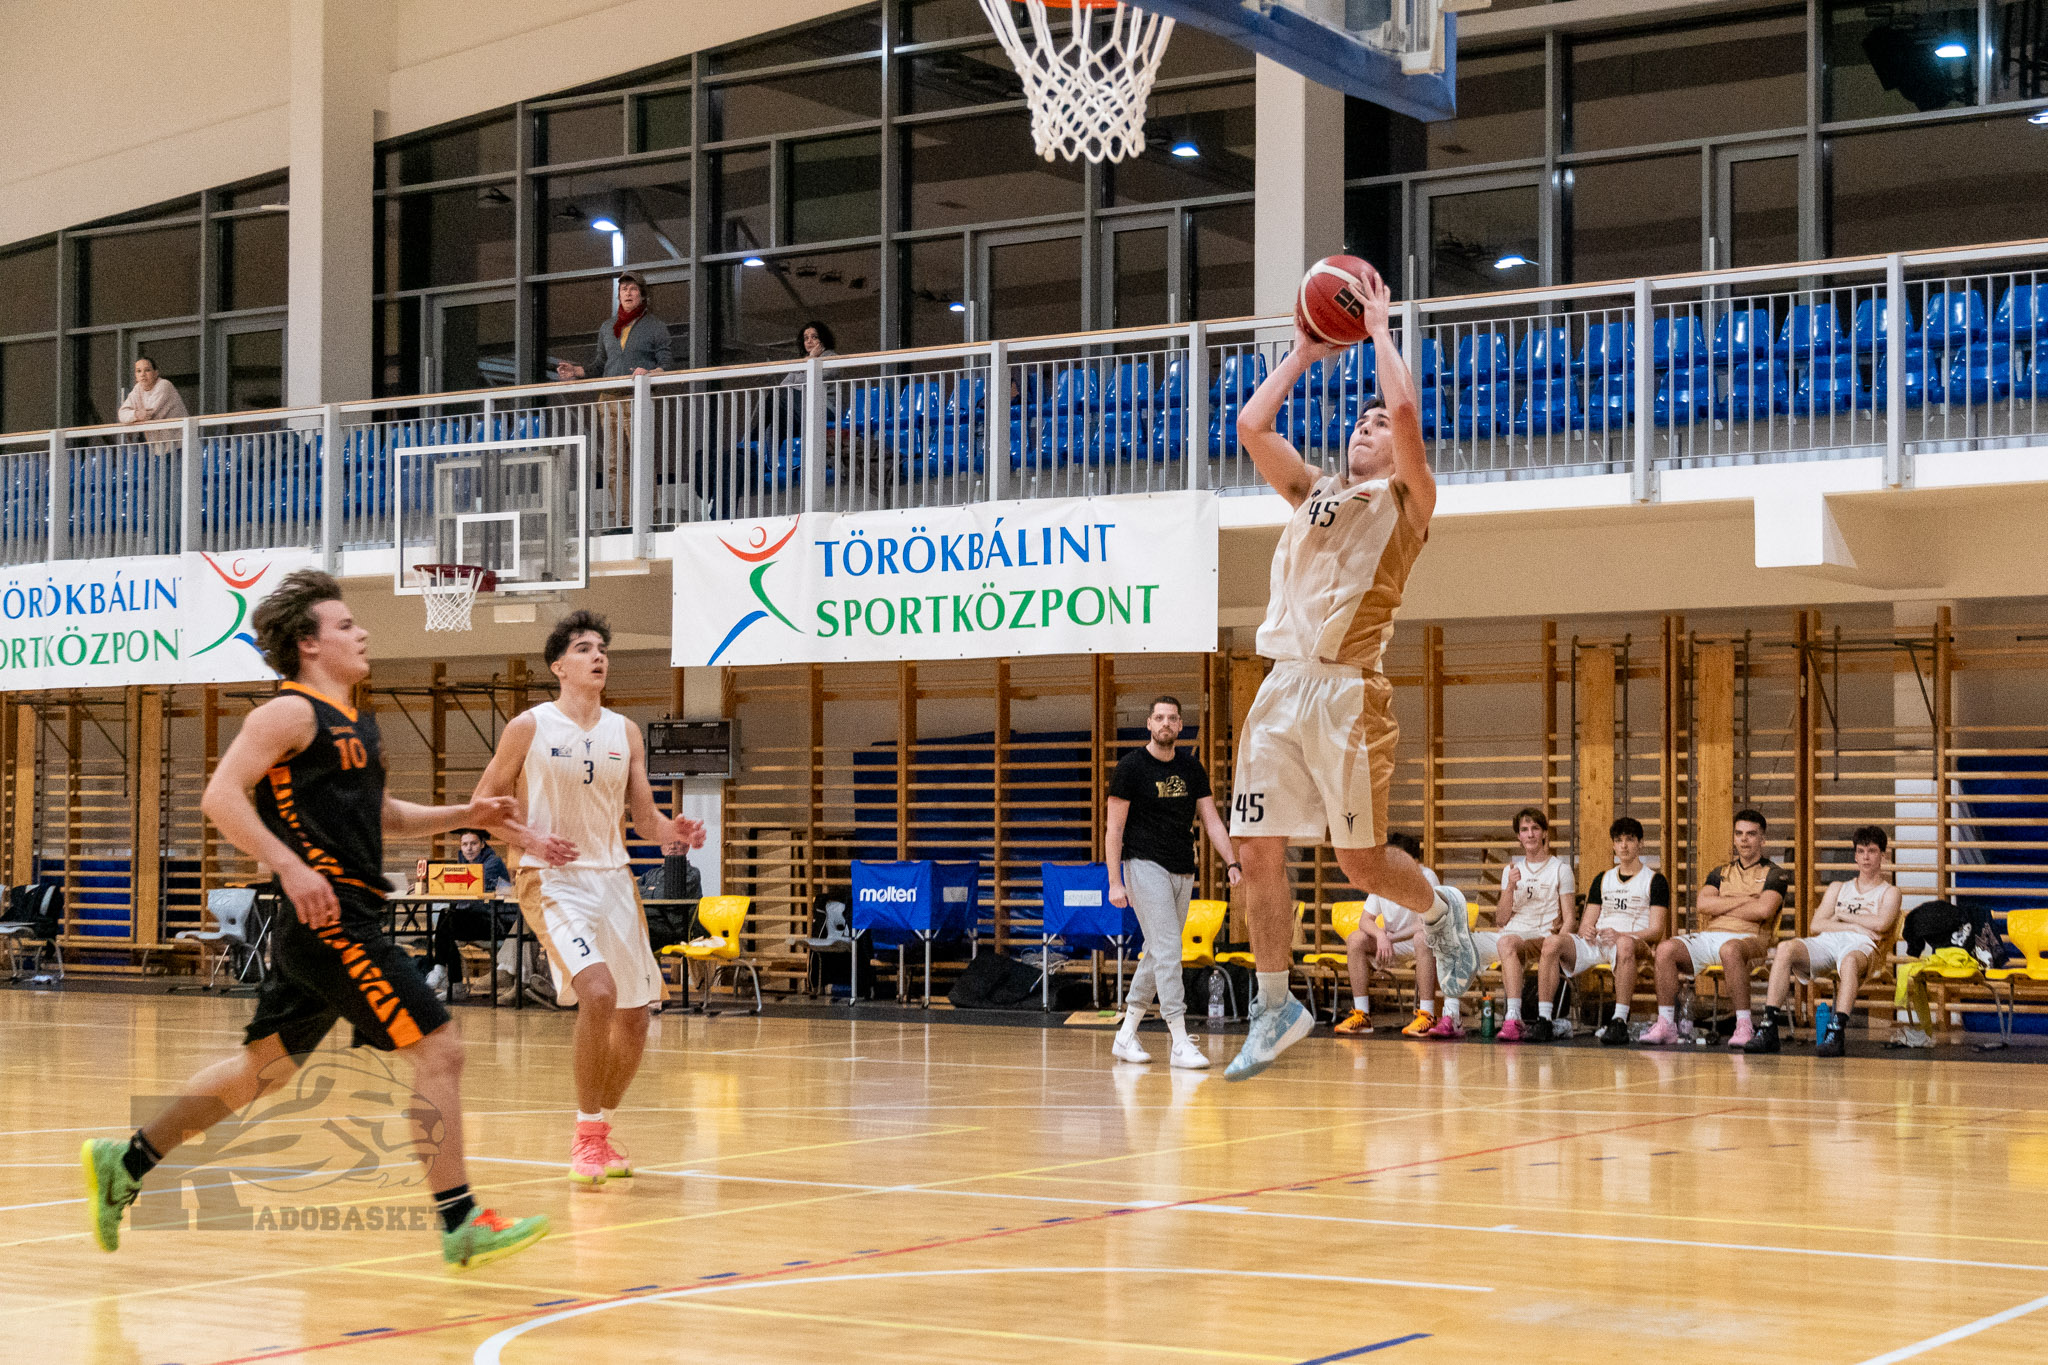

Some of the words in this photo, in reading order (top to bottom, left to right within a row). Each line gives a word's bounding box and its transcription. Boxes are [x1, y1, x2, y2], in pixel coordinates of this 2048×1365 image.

[1309, 501, 1339, 528] 45
[815, 517, 1116, 578] TÖRÖKBÁLINT
[0, 570, 183, 620] ÖRÖKBÁLIN
[816, 582, 1160, 638] SPORTKÖZPONT
[333, 737, 368, 771] 10
[583, 760, 595, 785] 3
[1235, 793, 1265, 823] 45
[860, 886, 916, 903] molten
[1613, 897, 1628, 911] 36
[572, 937, 591, 957] 3
